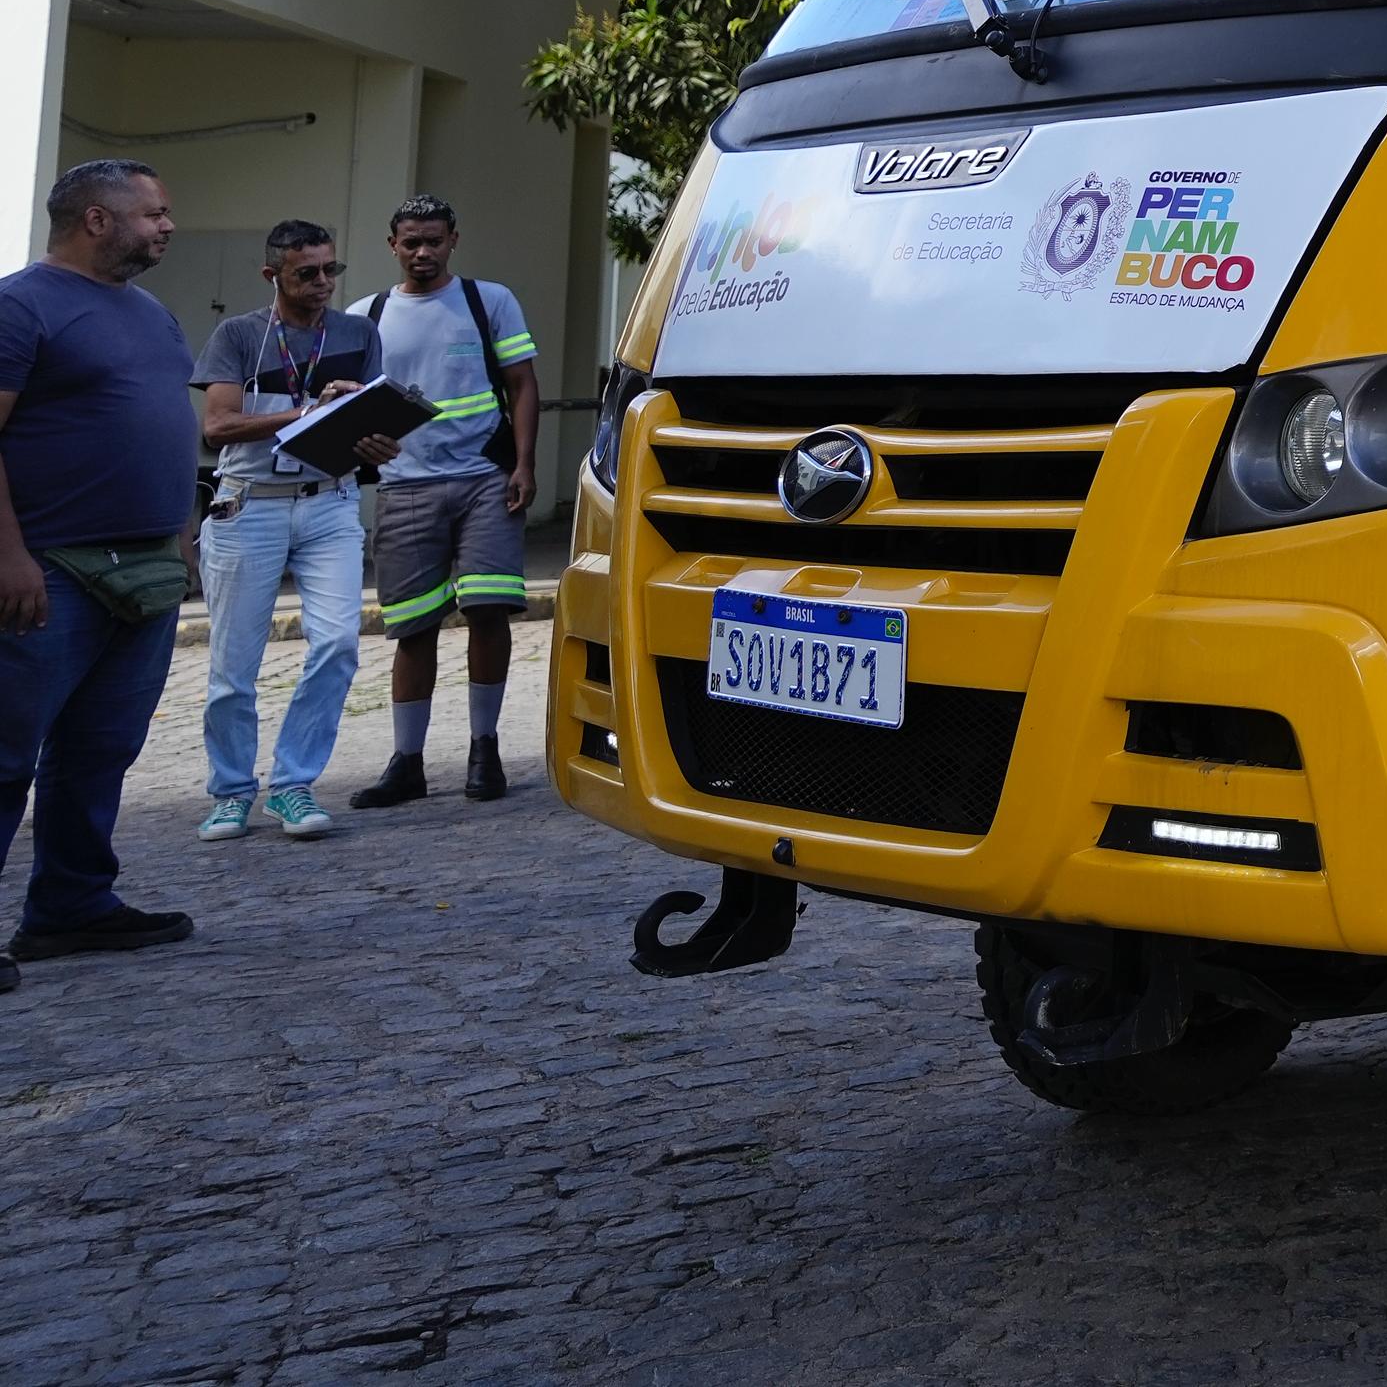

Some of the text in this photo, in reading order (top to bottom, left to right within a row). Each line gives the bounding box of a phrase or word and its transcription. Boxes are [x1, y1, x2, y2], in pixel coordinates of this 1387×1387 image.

[862, 146, 1009, 185] Volare
[1149, 171, 1242, 184] GOVERNO DE
[1135, 187, 1235, 221] PER
[928, 212, 1013, 231] Secretaria
[1125, 219, 1240, 255] NAM
[893, 241, 1003, 264] de Educação
[1115, 253, 1255, 292] BUCO
[673, 270, 790, 326] pela Educação
[1109, 293, 1245, 313] ESTADO DE MUDANÇA
[785, 606, 816, 624] BRASIL
[711, 673, 721, 692] BR
[725, 627, 880, 711] SOV1B71
